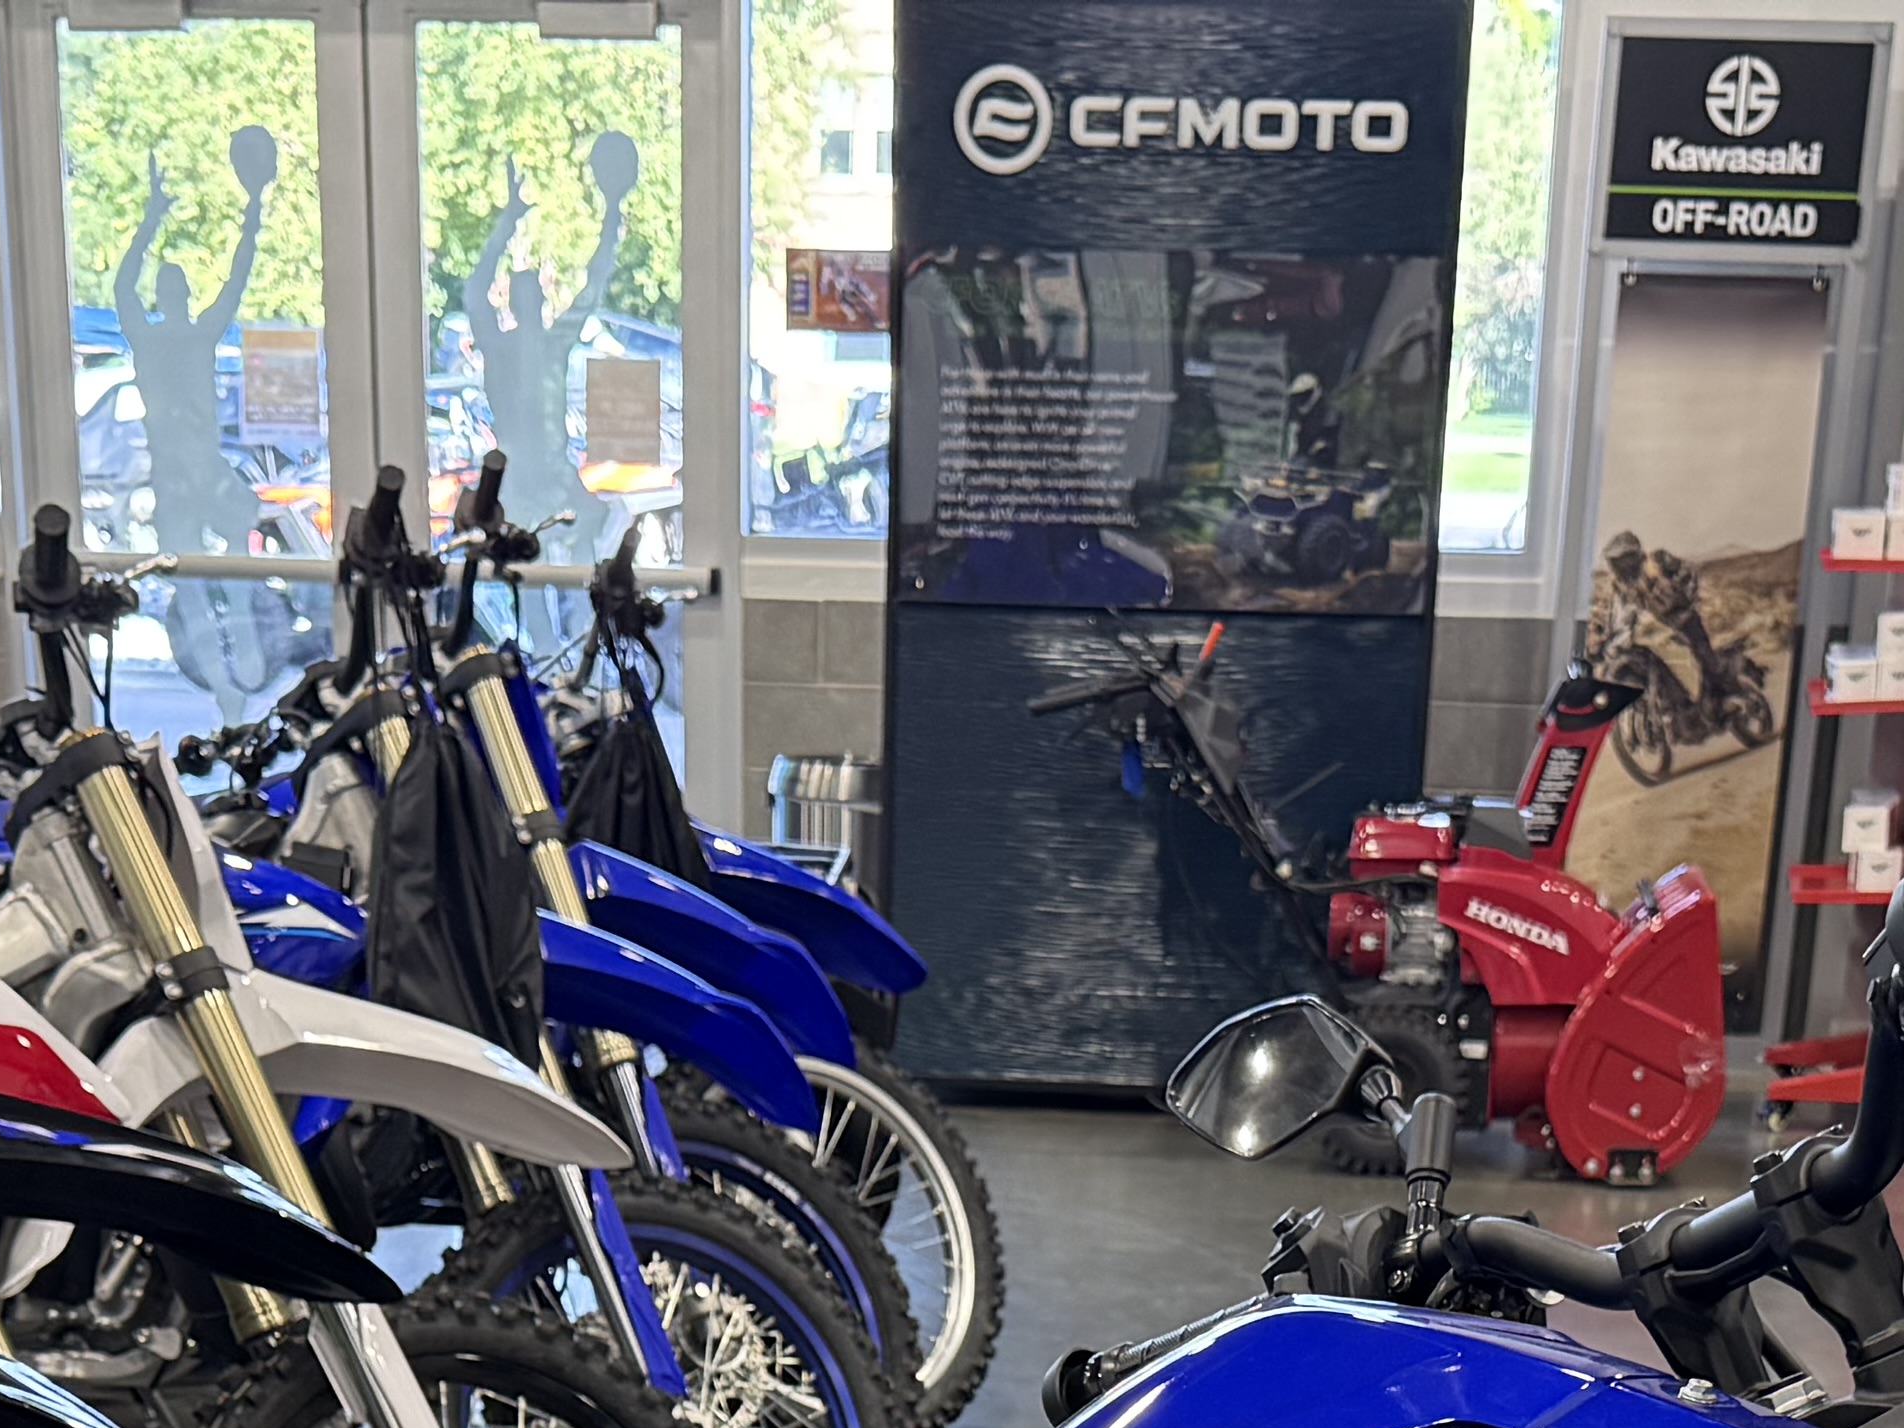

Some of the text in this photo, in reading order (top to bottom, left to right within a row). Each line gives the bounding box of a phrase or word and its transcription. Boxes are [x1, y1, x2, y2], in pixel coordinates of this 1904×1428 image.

[1069, 96, 1409, 153] CFMOTO
[1651, 136, 1824, 175] Kawasaki
[1652, 198, 1818, 238] OFF-ROAD
[1464, 896, 1570, 956] HONDA
